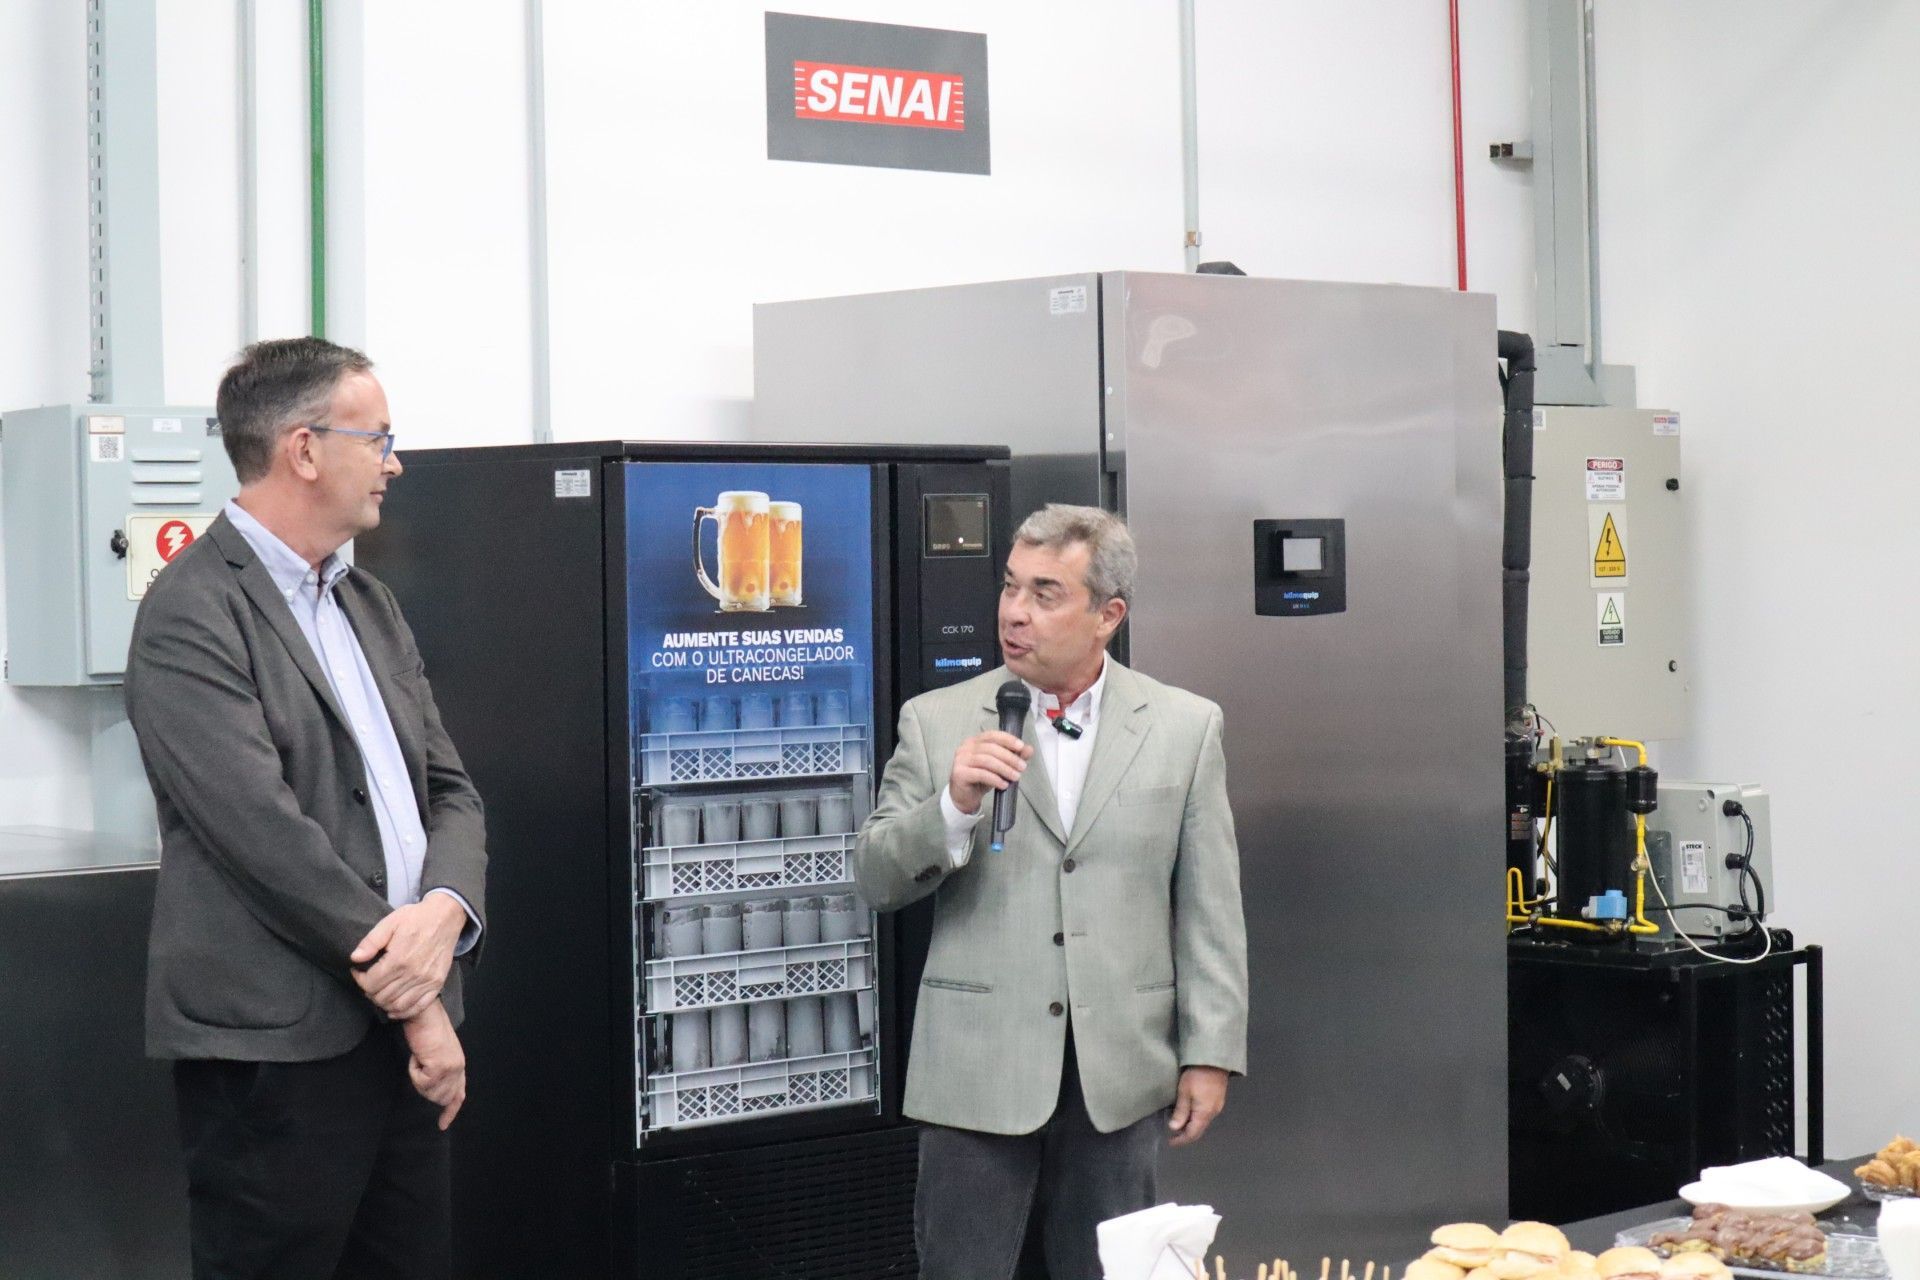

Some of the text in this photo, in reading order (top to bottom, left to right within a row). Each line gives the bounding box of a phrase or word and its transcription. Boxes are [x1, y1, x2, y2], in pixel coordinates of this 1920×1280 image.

[807, 69, 952, 121] SENAI
[1592, 461, 1618, 469] PERIGO
[663, 628, 844, 648] AUMENTE SUAS VENDAS
[942, 625, 974, 634] CCK 170
[652, 646, 854, 667] COM O ULTRACONGELADOR
[706, 666, 804, 683] DE CANECAS!
